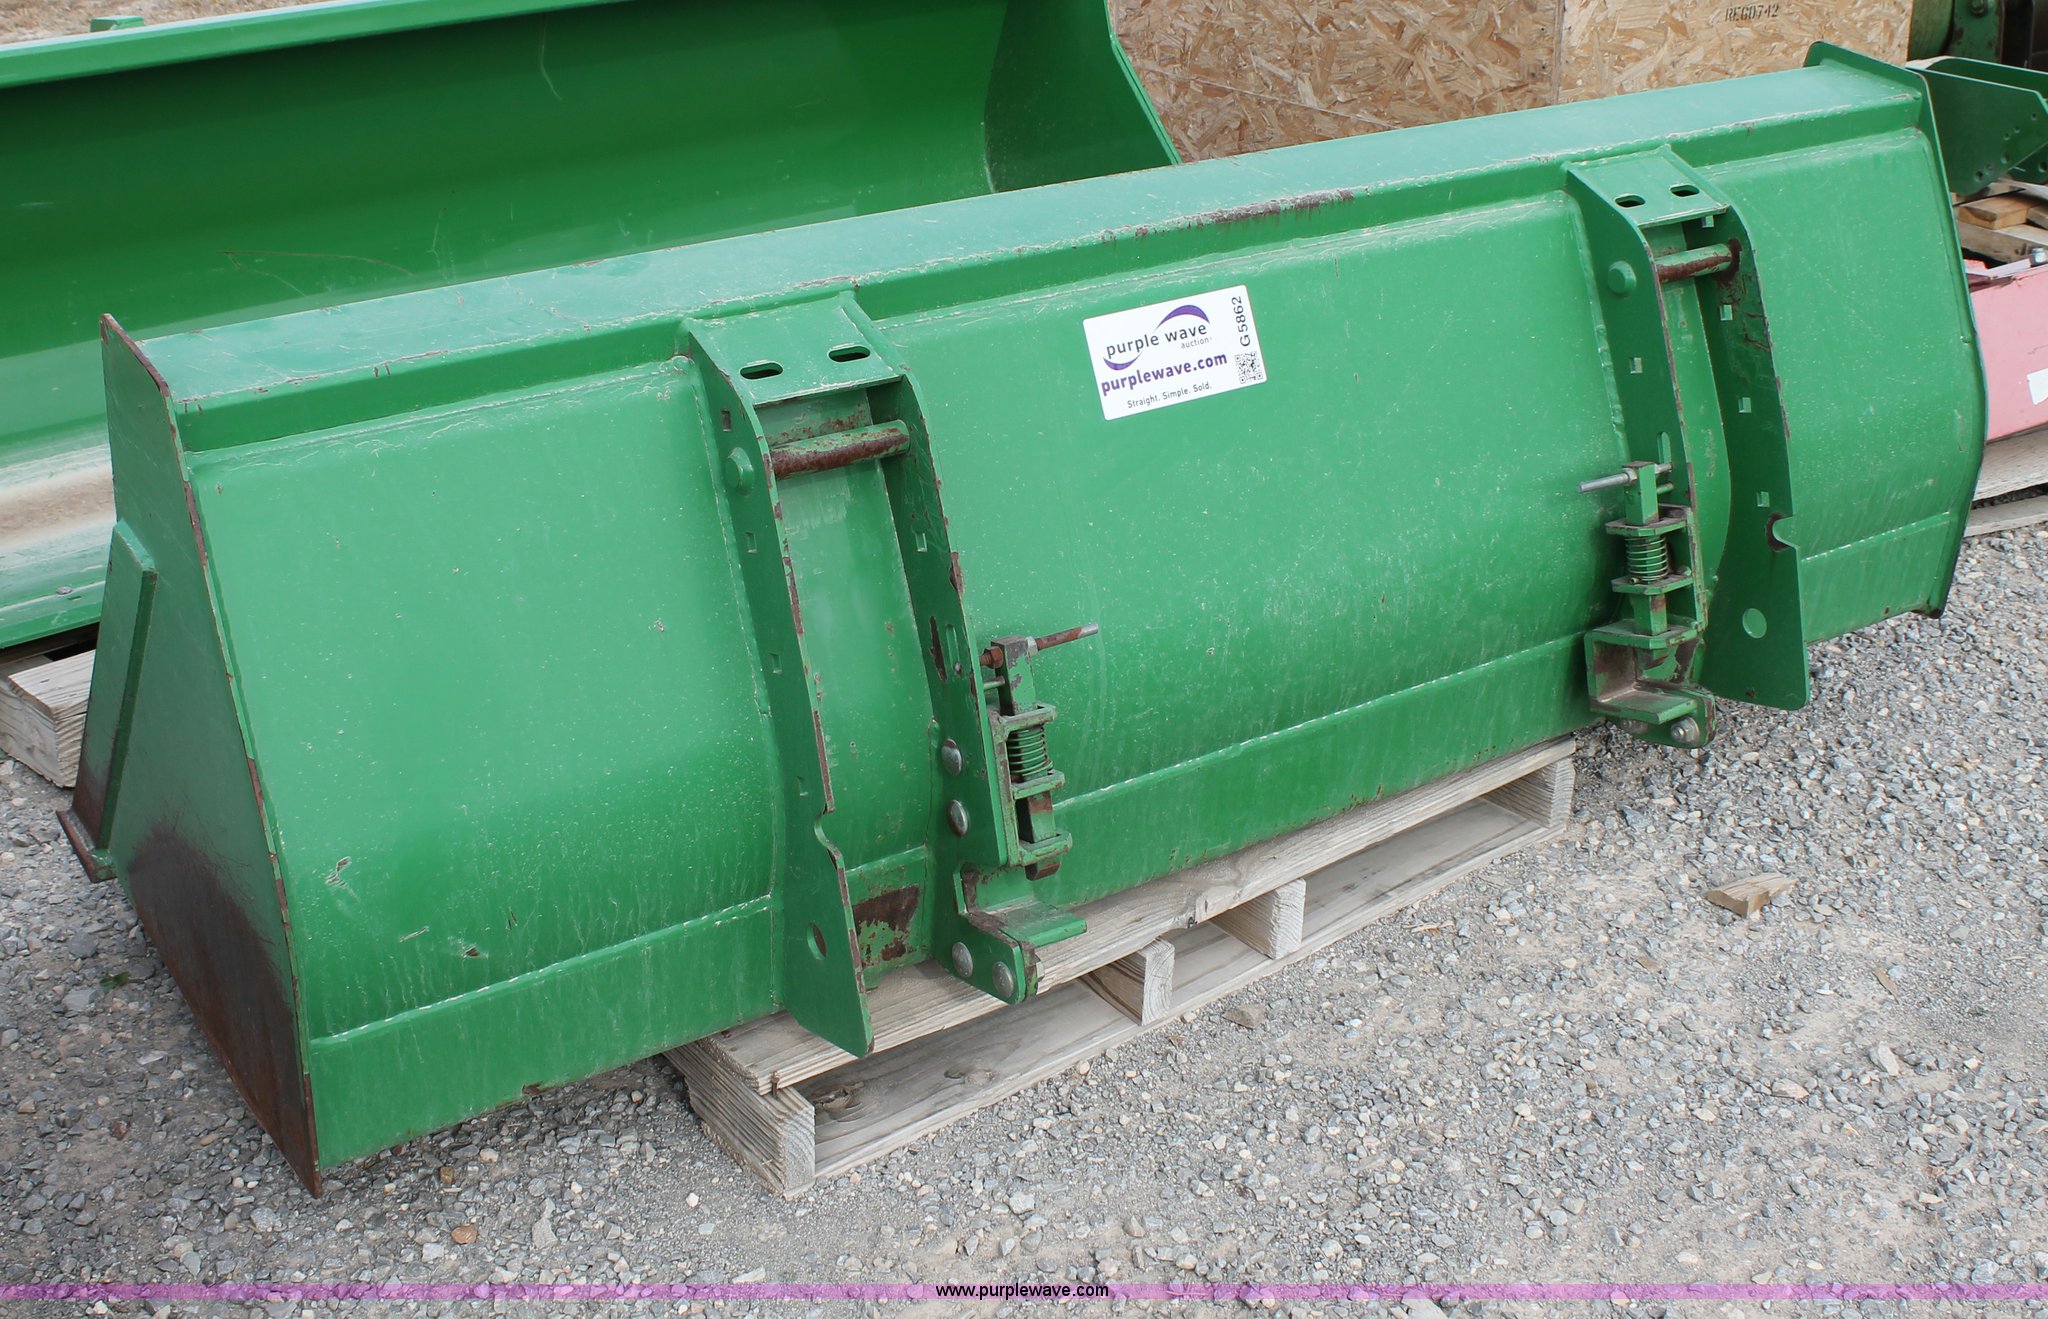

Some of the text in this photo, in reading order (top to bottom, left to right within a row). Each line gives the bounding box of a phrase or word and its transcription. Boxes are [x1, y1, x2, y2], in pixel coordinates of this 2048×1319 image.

[1106, 324, 1207, 359] purple wave
[1180, 337, 1210, 350] auction
[1101, 352, 1228, 397] purplewave.com
[1127, 381, 1213, 409] Straight. Simple. Sold.
